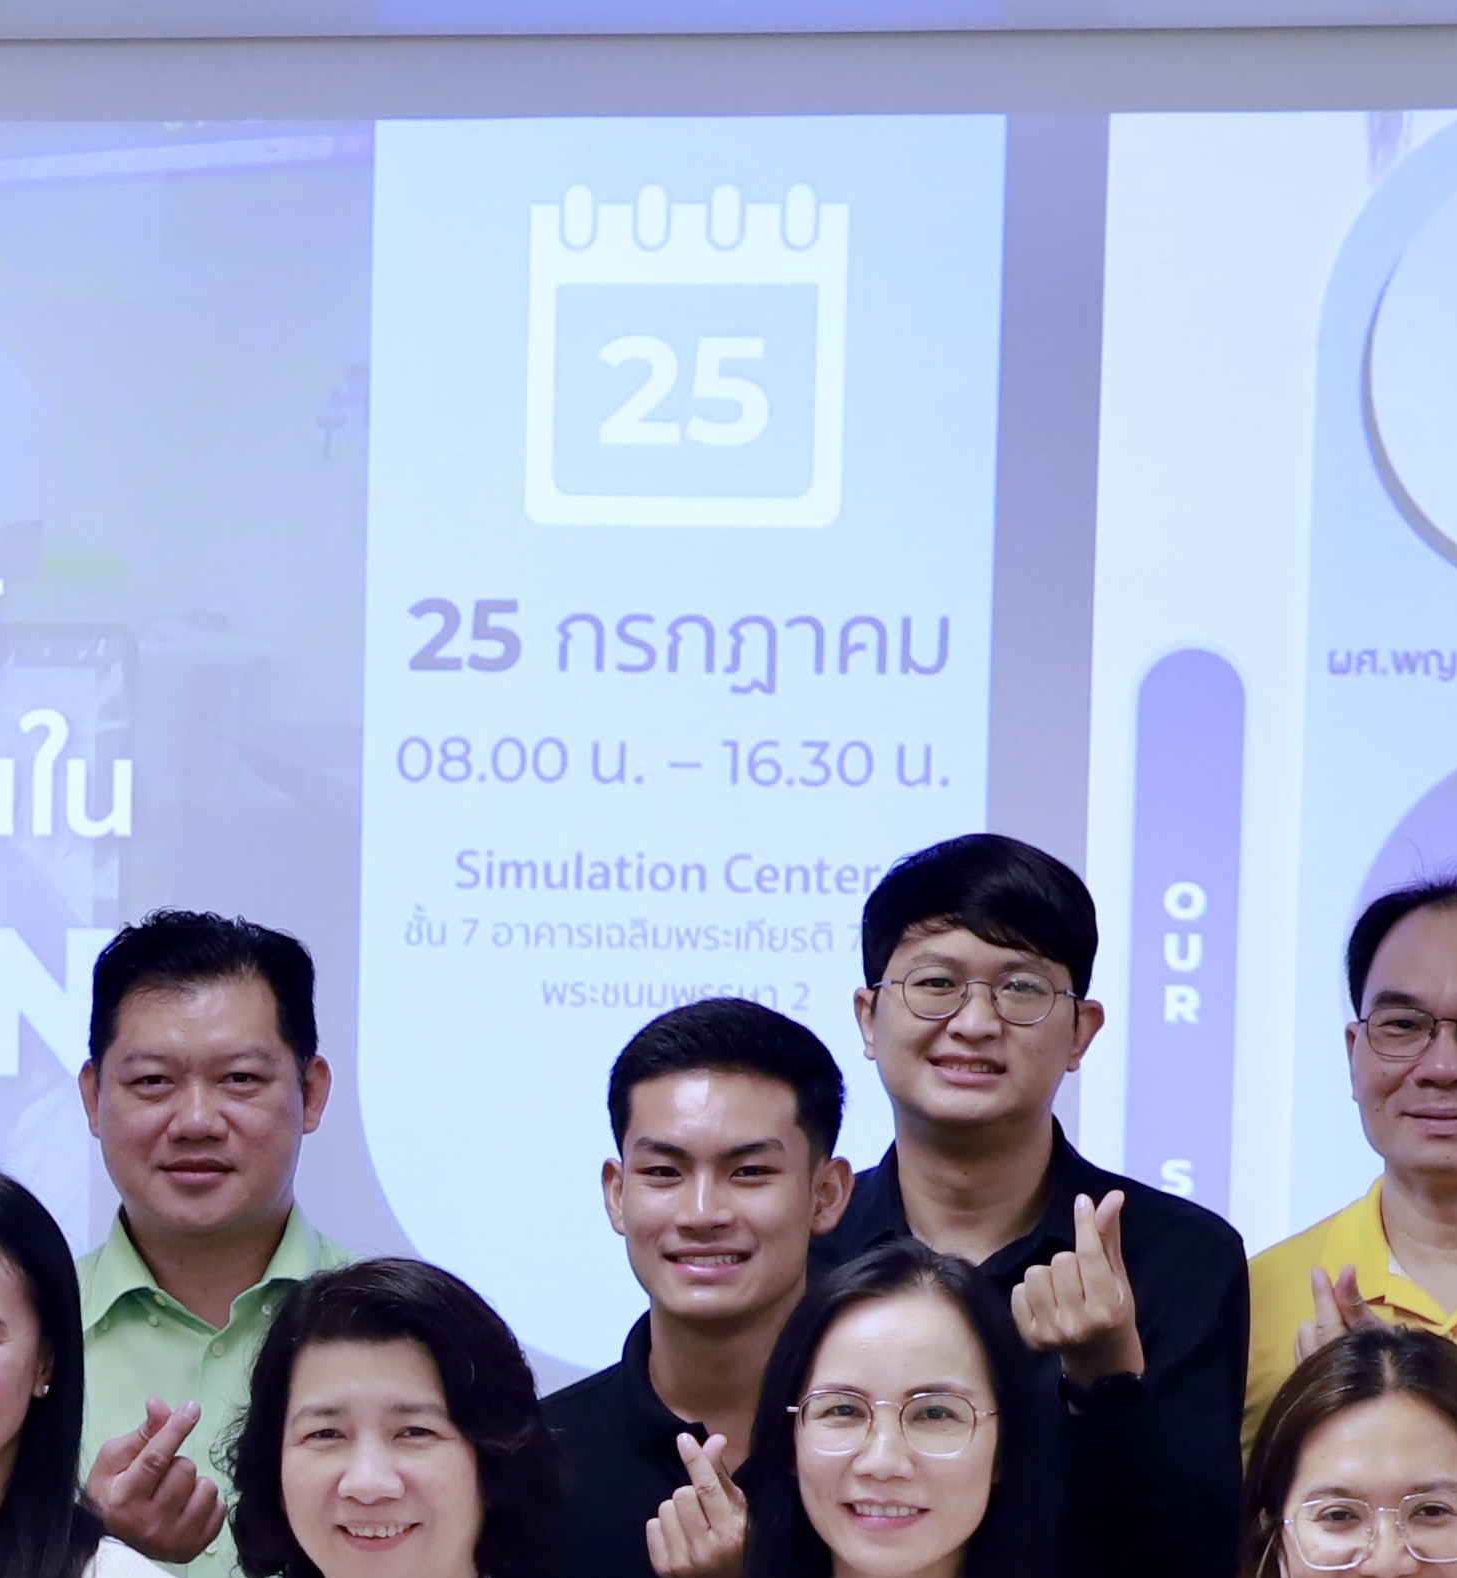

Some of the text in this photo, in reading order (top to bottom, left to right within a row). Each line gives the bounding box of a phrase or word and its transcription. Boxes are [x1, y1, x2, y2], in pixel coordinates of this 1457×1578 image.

[597, 334, 771, 447] 25
[407, 597, 951, 695] 25 กรกฎาคม
[396, 735, 569, 784] 08.00
[590, 740, 644, 785] น.
[722, 739, 875, 788] 16.30
[895, 742, 950, 788] น.
[455, 849, 883, 895] Simulation Center
[404, 903, 447, 948] ชั้น
[460, 917, 480, 947] 7
[791, 981, 811, 1012] 2
